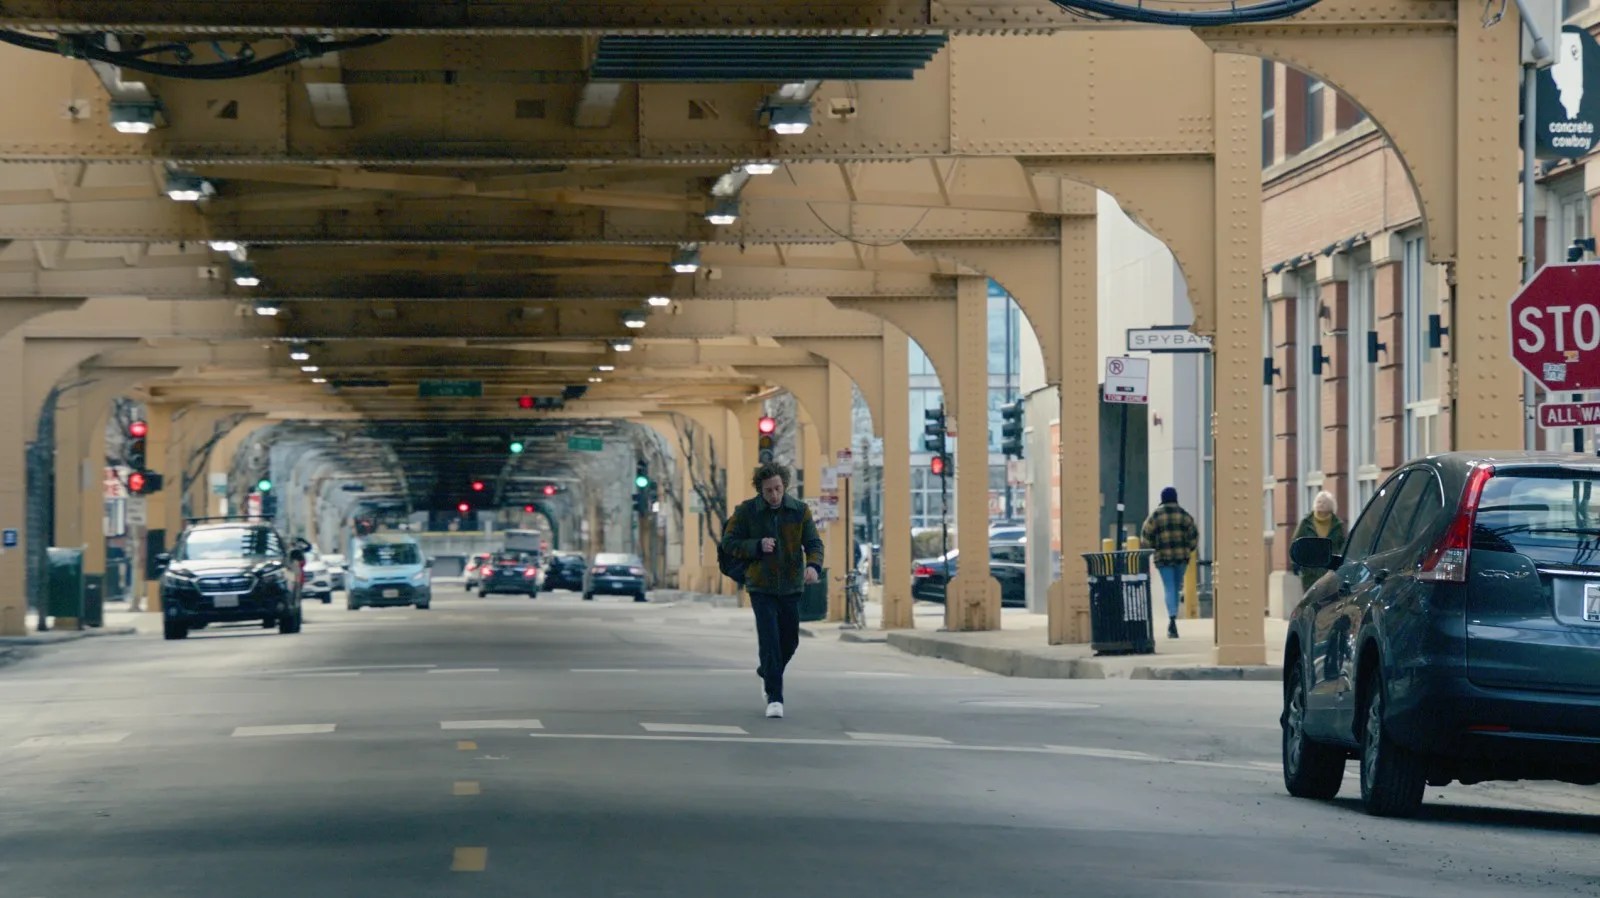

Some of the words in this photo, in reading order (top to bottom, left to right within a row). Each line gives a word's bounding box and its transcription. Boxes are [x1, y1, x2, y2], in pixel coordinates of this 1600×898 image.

[1549, 121, 1593, 133] concrete
[1552, 134, 1591, 149] cowboy
[1547, 407, 1576, 423] ALL
